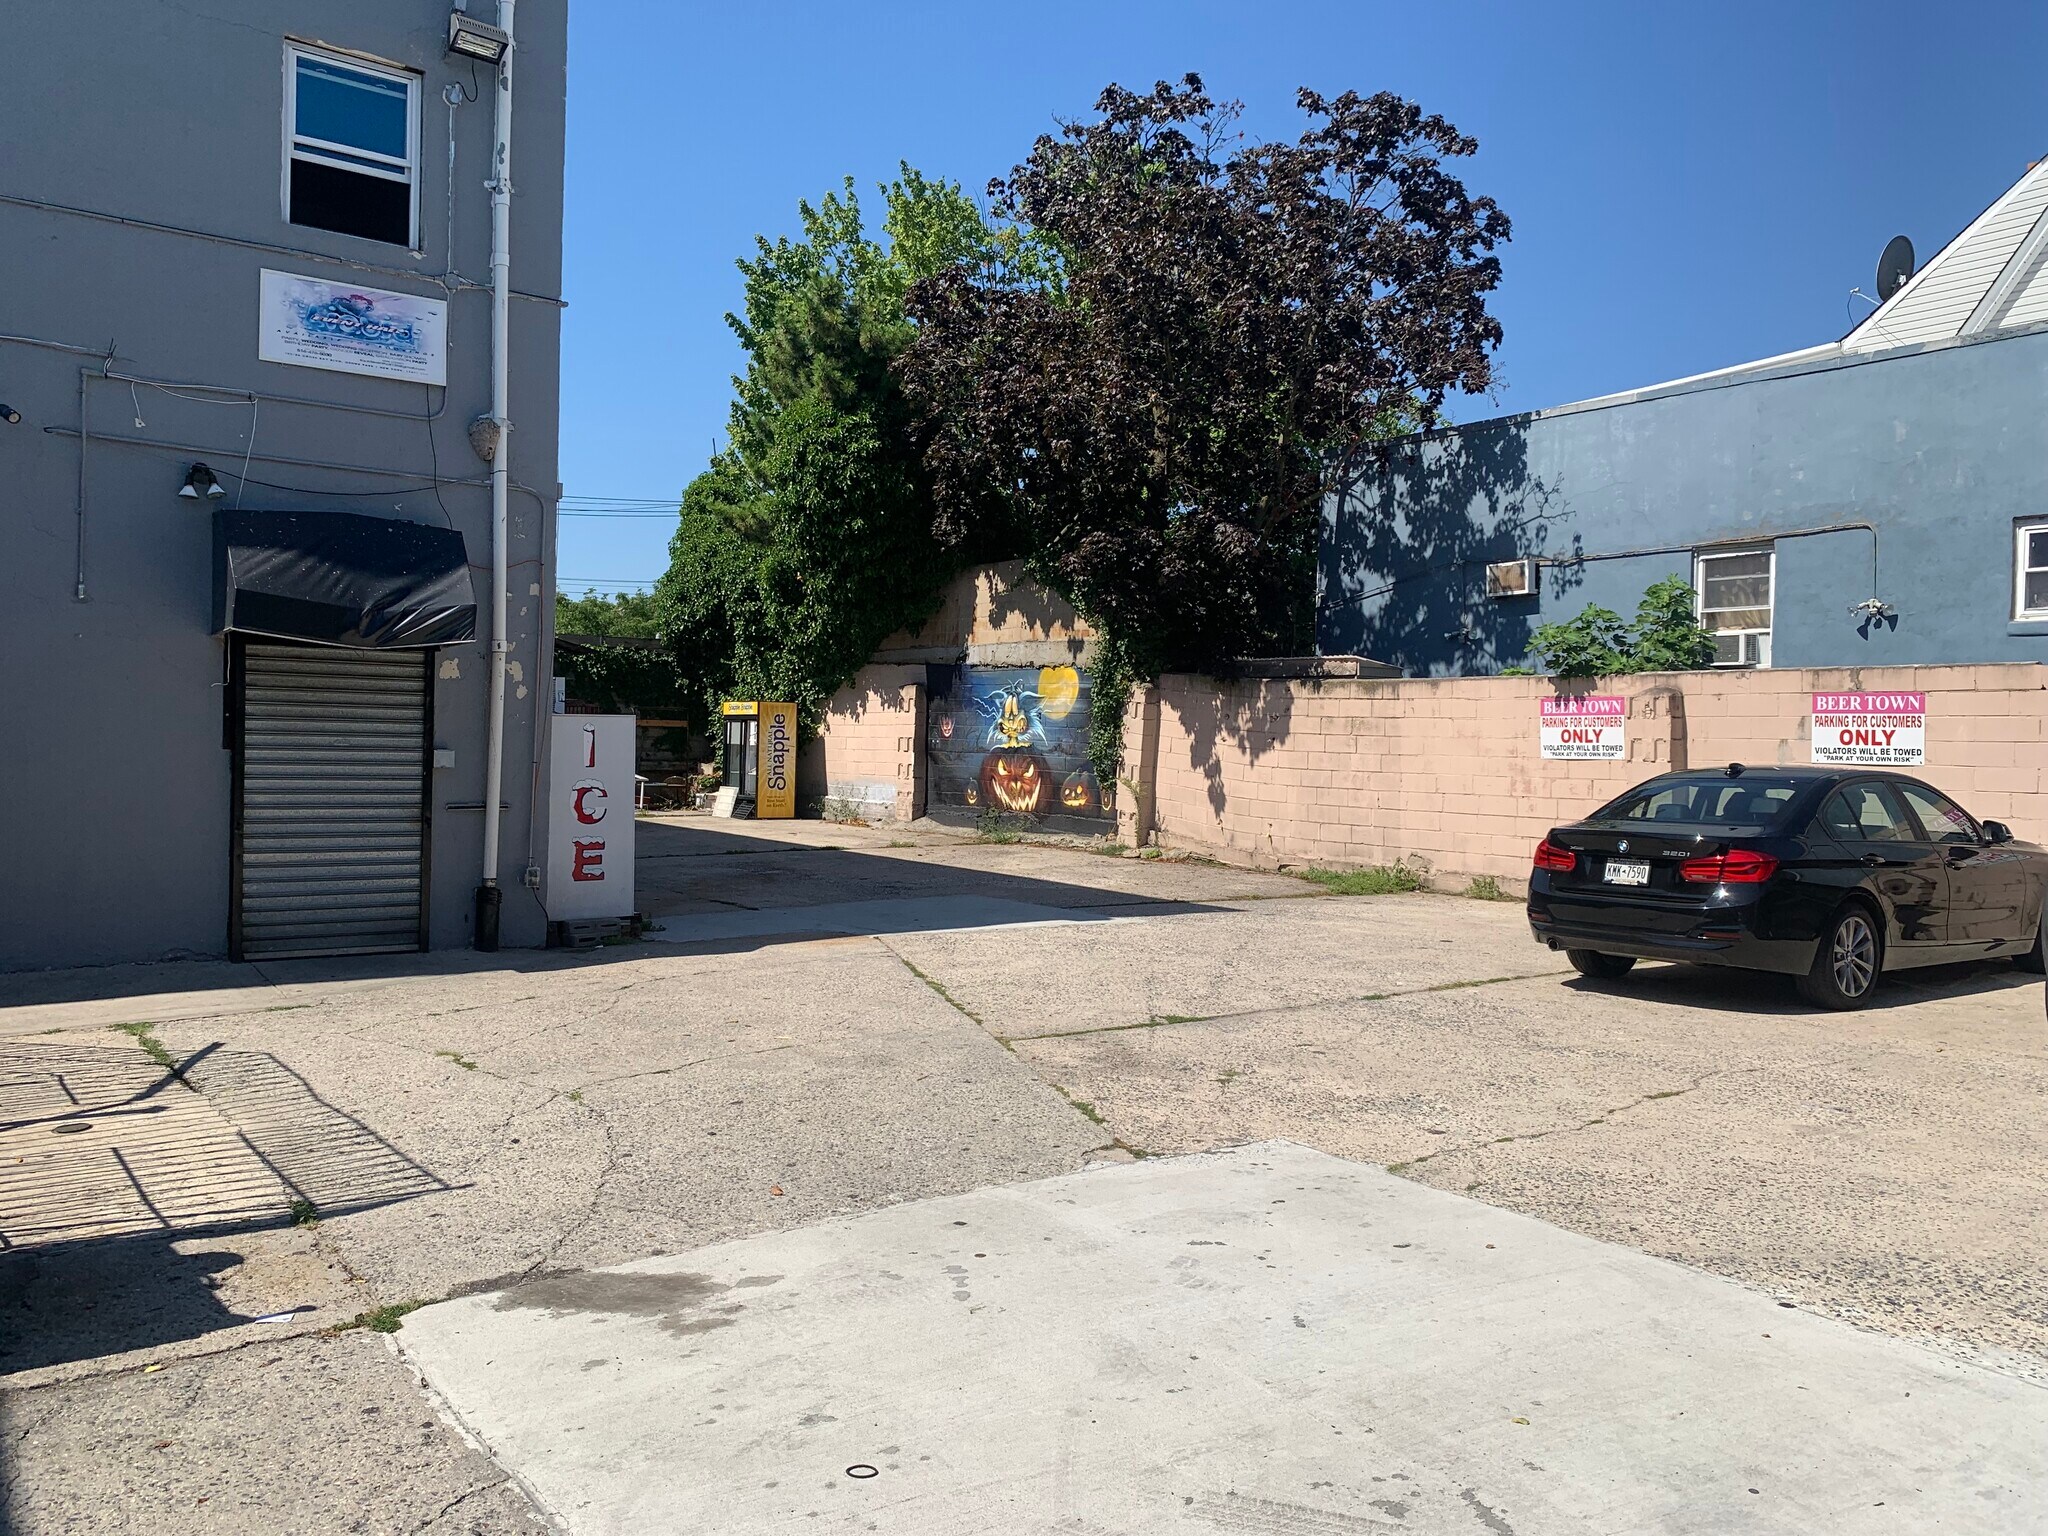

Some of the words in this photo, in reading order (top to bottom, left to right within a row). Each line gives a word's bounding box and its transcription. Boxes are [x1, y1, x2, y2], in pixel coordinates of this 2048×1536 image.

[1544, 701, 1578, 713] BEER
[1582, 700, 1621, 713] TOWN
[1816, 696, 1861, 710] BEER
[1865, 695, 1921, 710] TOWN
[1542, 717, 1568, 727] PARKING
[1570, 717, 1582, 727] FOR
[1584, 717, 1622, 727] CUSTOMERS
[1815, 716, 1849, 727] PARKING
[1852, 716, 1867, 727] FOR
[1870, 716, 1922, 728] CUSTOMERS
[1561, 729, 1603, 743] ONLY
[1840, 729, 1896, 746] ONLY
[768, 714, 790, 790] Snapple
[570, 722, 608, 881] ICE
